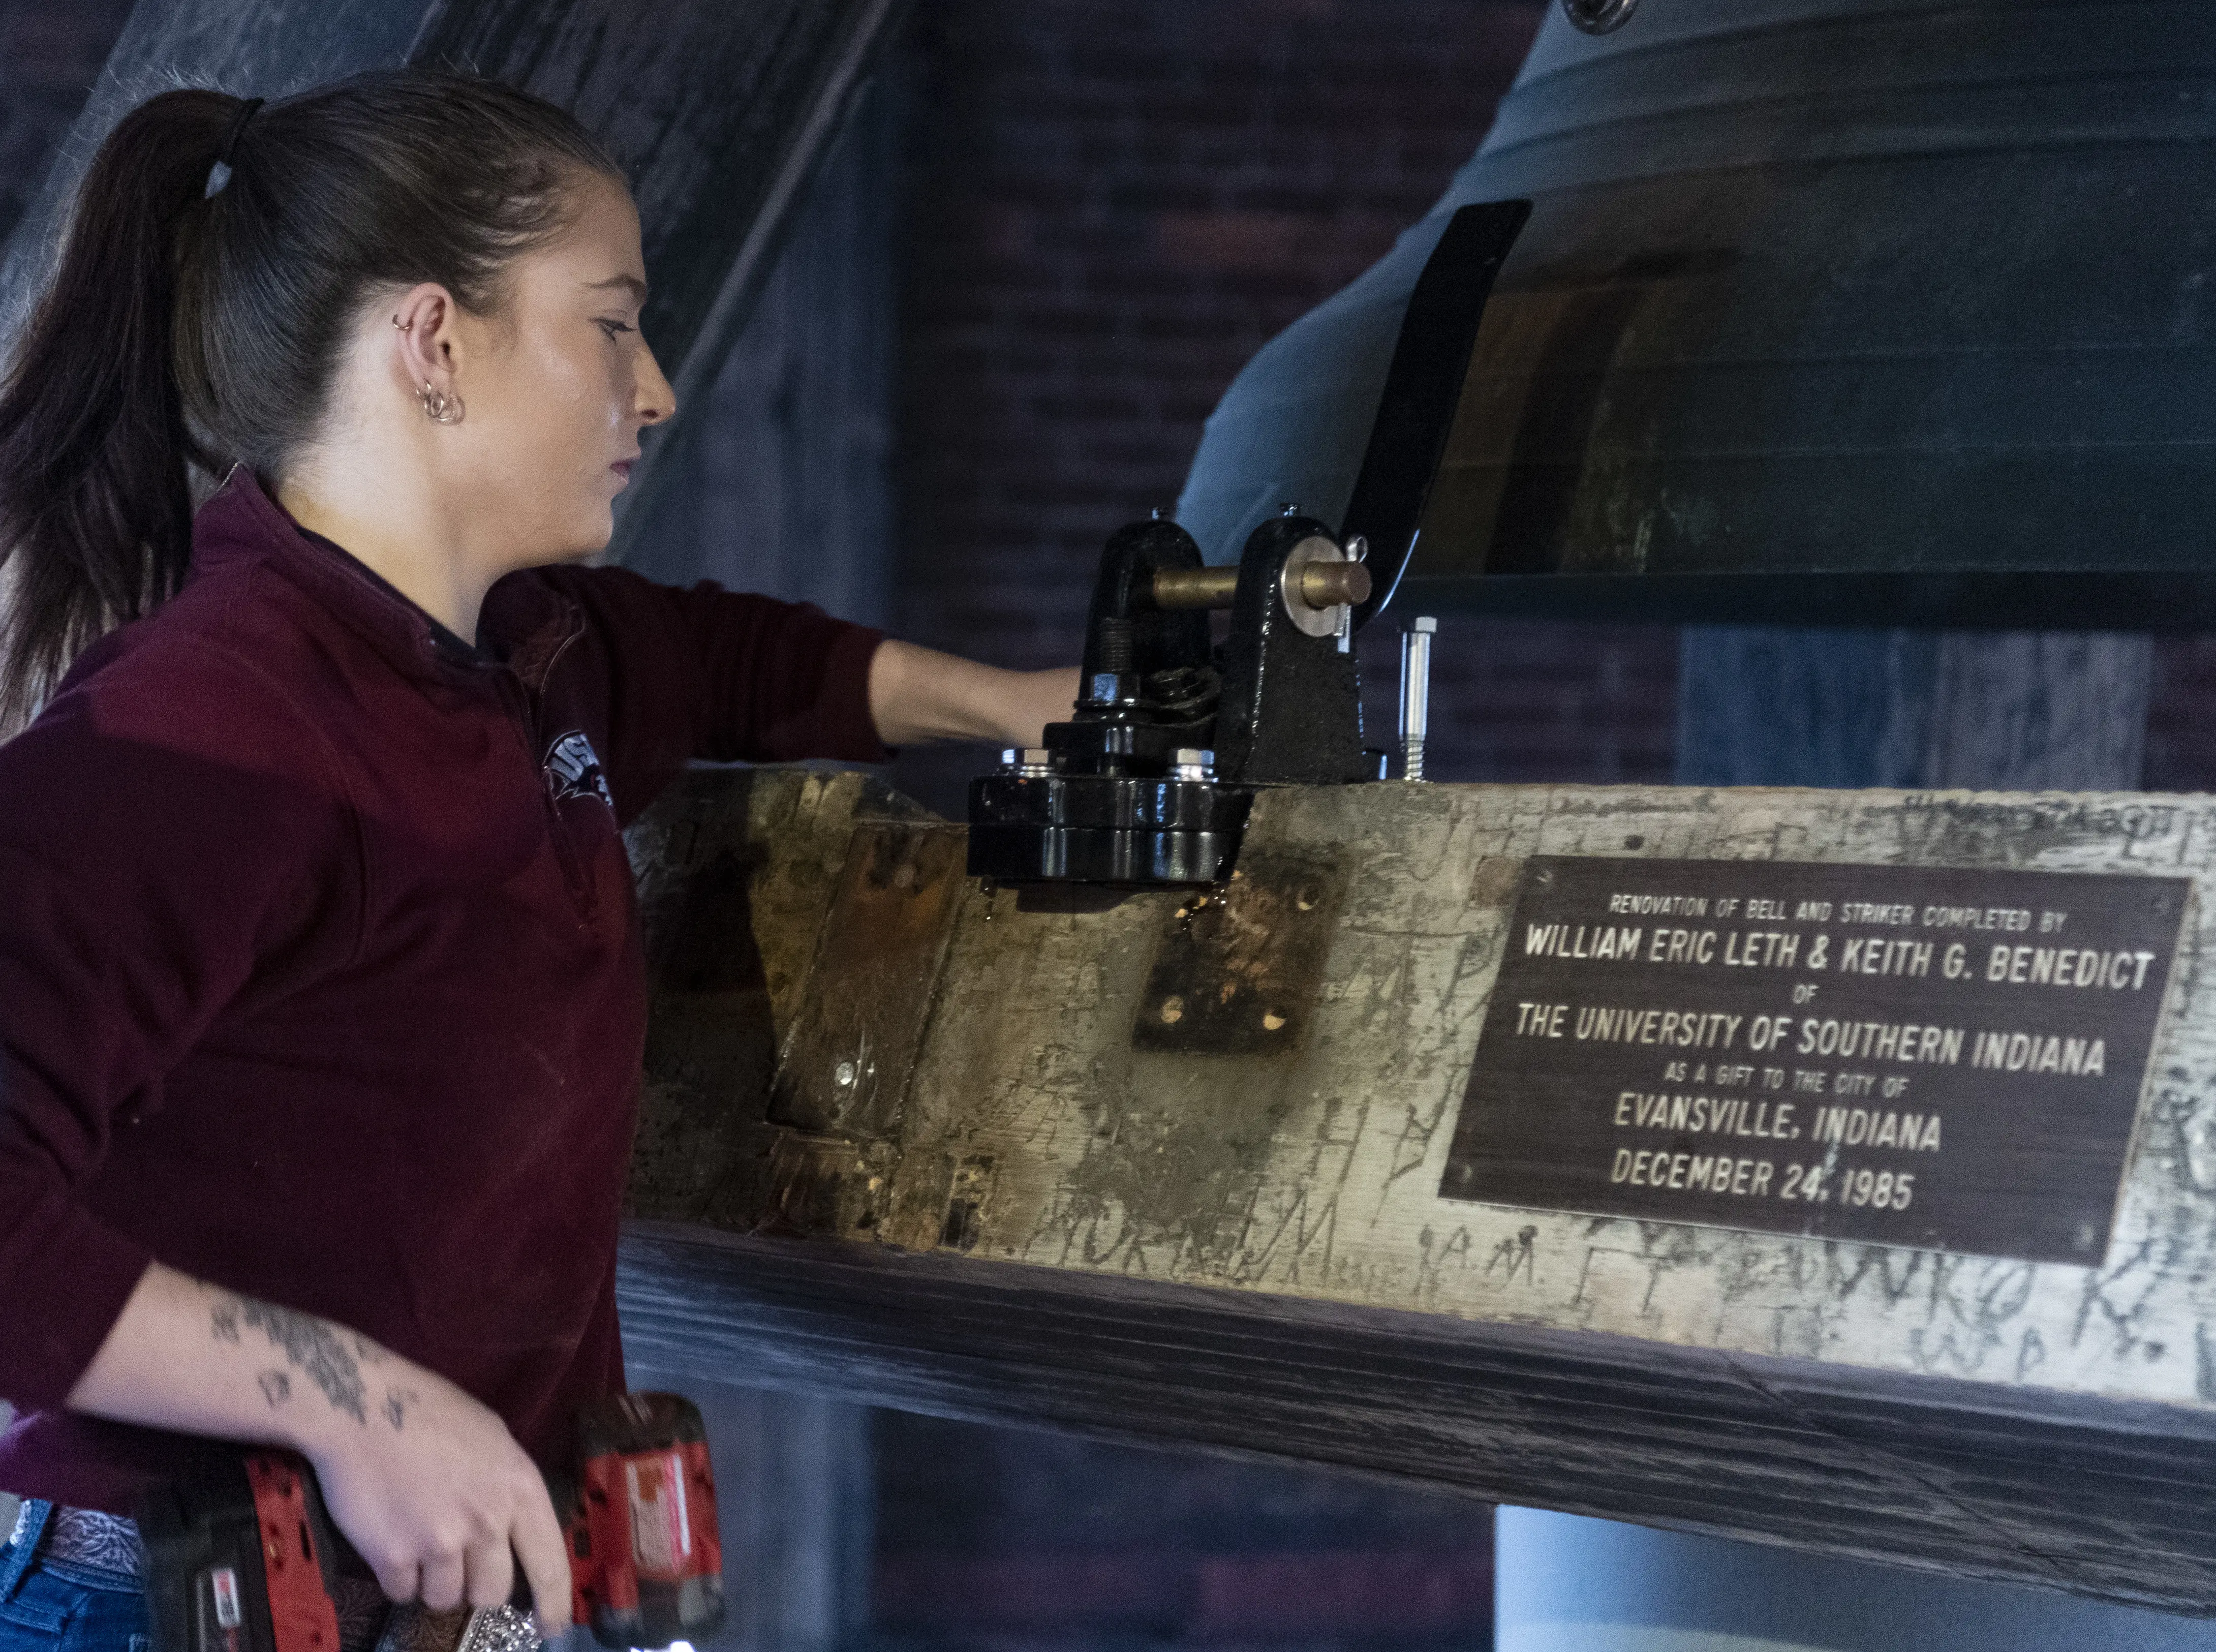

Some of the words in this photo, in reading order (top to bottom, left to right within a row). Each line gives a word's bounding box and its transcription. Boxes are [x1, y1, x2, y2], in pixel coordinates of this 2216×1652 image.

[1609, 893, 1708, 916] RENOVATION
[1715, 897, 1740, 917] OF
[1745, 898, 1786, 921] BELL
[1795, 900, 1833, 922] AND
[1840, 901, 1915, 925] STRIKER
[1923, 905, 2032, 931] COMPLETED
[2040, 910, 2068, 933] BY
[1524, 923, 1642, 960] WILLIAM
[1648, 929, 1717, 965] ERIC
[1723, 932, 1799, 967] LETH
[1806, 934, 1829, 970] &
[1840, 939, 1933, 976] KEITH
[1942, 942, 1973, 980] G.
[1986, 944, 2156, 990] BENEDICT
[1792, 983, 1819, 1004] OF
[1516, 1001, 1569, 1038] THE
[1575, 1006, 1743, 1047] UNIVERSITY
[1749, 1014, 1793, 1051] OF
[1797, 1018, 1965, 1065] SOUTHERN
[1972, 1031, 2105, 1077] INDIANA
[1664, 1061, 1687, 1082] AS
[1692, 1063, 1707, 1083] A
[1716, 1064, 1755, 1085] GIFT
[1764, 1066, 1784, 1089] TO
[1795, 1069, 1826, 1093] THE
[1835, 1073, 1875, 1093] CITY
[1883, 1076, 1910, 1097] OF
[1613, 1090, 1801, 1140] EVANSVILLE,
[1812, 1108, 1941, 1152] INDIANA
[1610, 1147, 1774, 1196] DECEMBER
[1841, 1170, 1916, 1211] 1985
